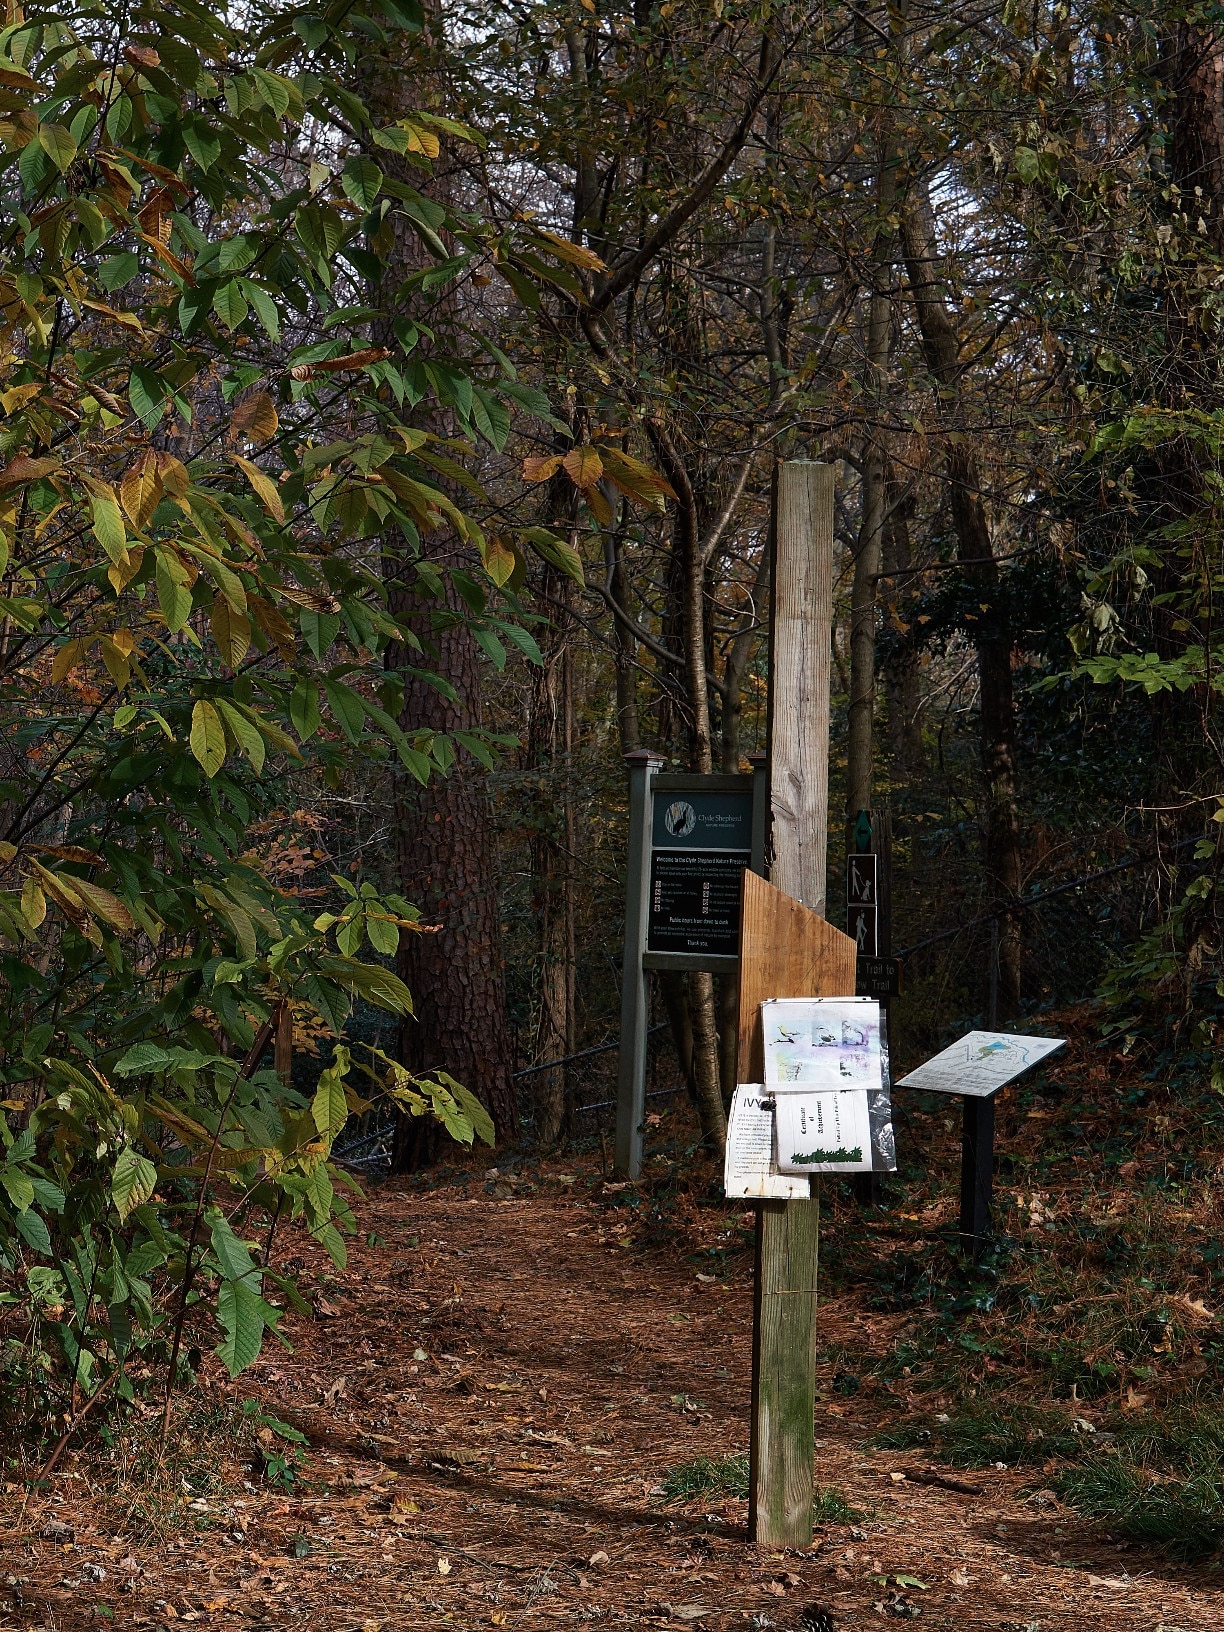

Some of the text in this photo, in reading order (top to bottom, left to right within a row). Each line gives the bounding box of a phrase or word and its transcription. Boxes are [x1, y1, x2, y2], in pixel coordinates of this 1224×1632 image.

[715, 814, 742, 824] Shepherd
[865, 962, 883, 975] Trail
[885, 963, 895, 975] to
[871, 979, 890, 991] Trail
[743, 1097, 763, 1108] IVY
